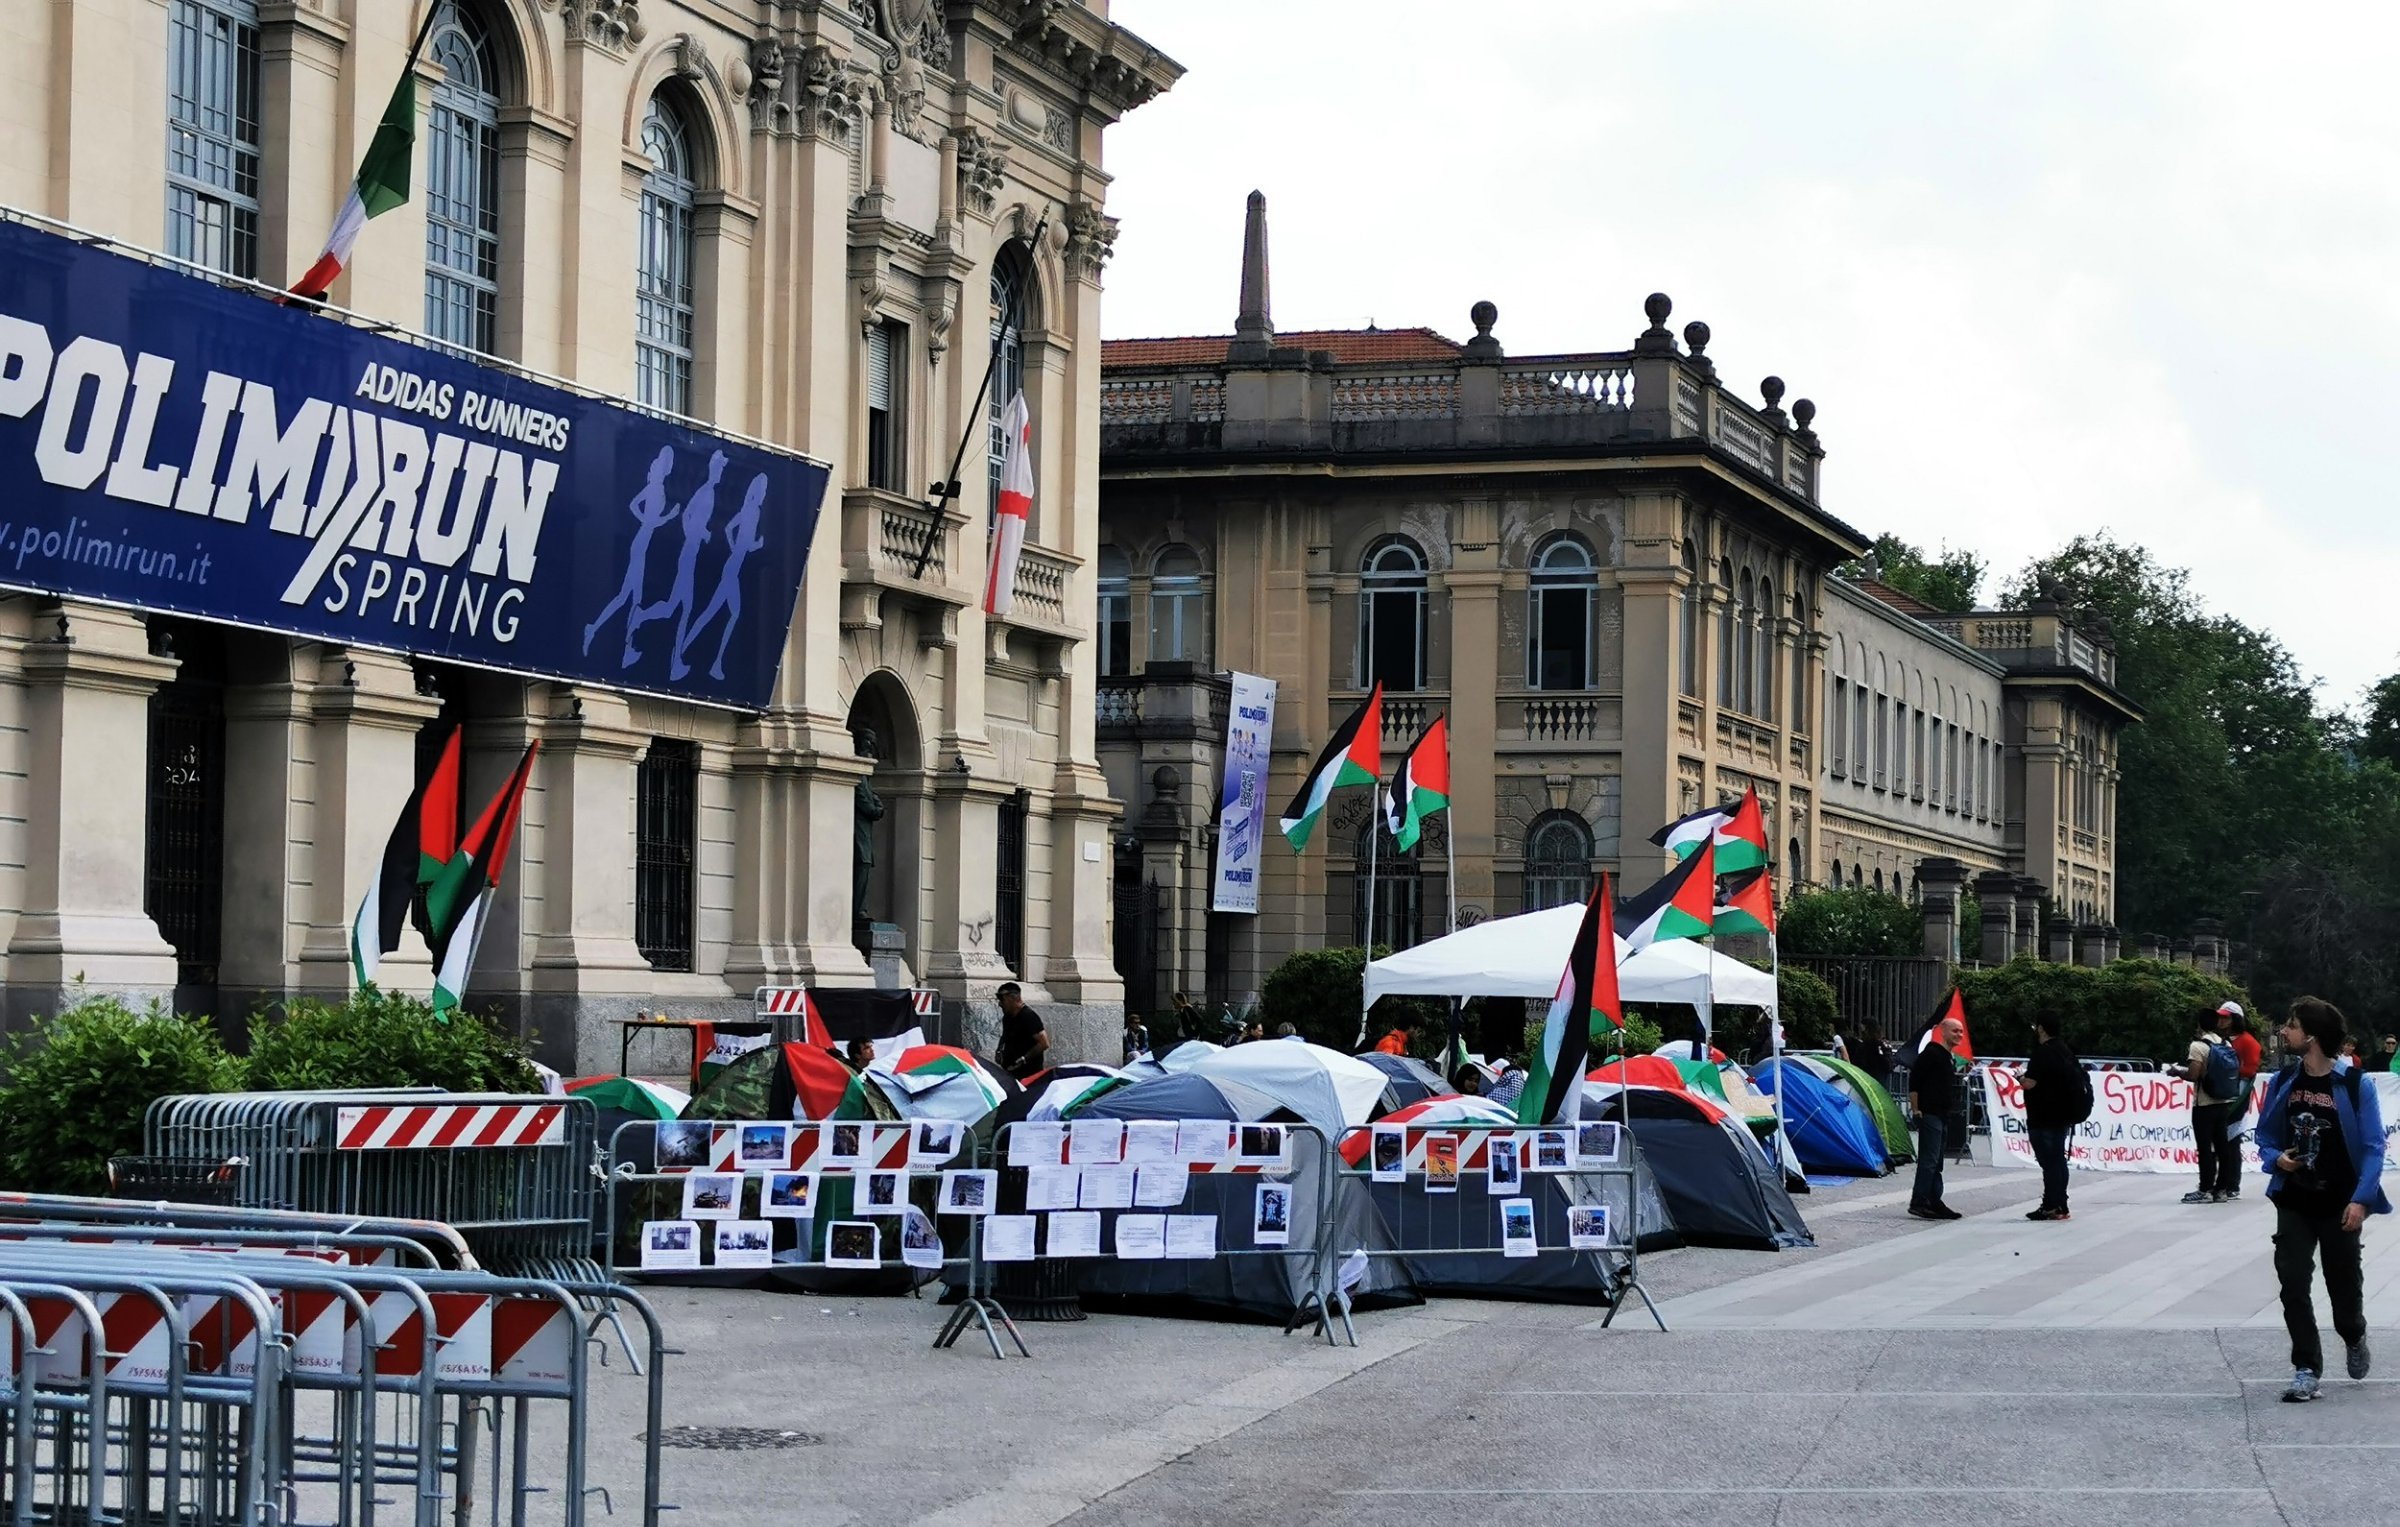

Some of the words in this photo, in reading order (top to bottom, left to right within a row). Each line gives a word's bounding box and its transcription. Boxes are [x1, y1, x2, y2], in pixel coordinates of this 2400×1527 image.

[355, 362, 456, 421] ADIDAS
[458, 390, 571, 452] RUNNERS
[323, 553, 525, 643] SPRING
[2110, 1123, 2123, 1141] LA
